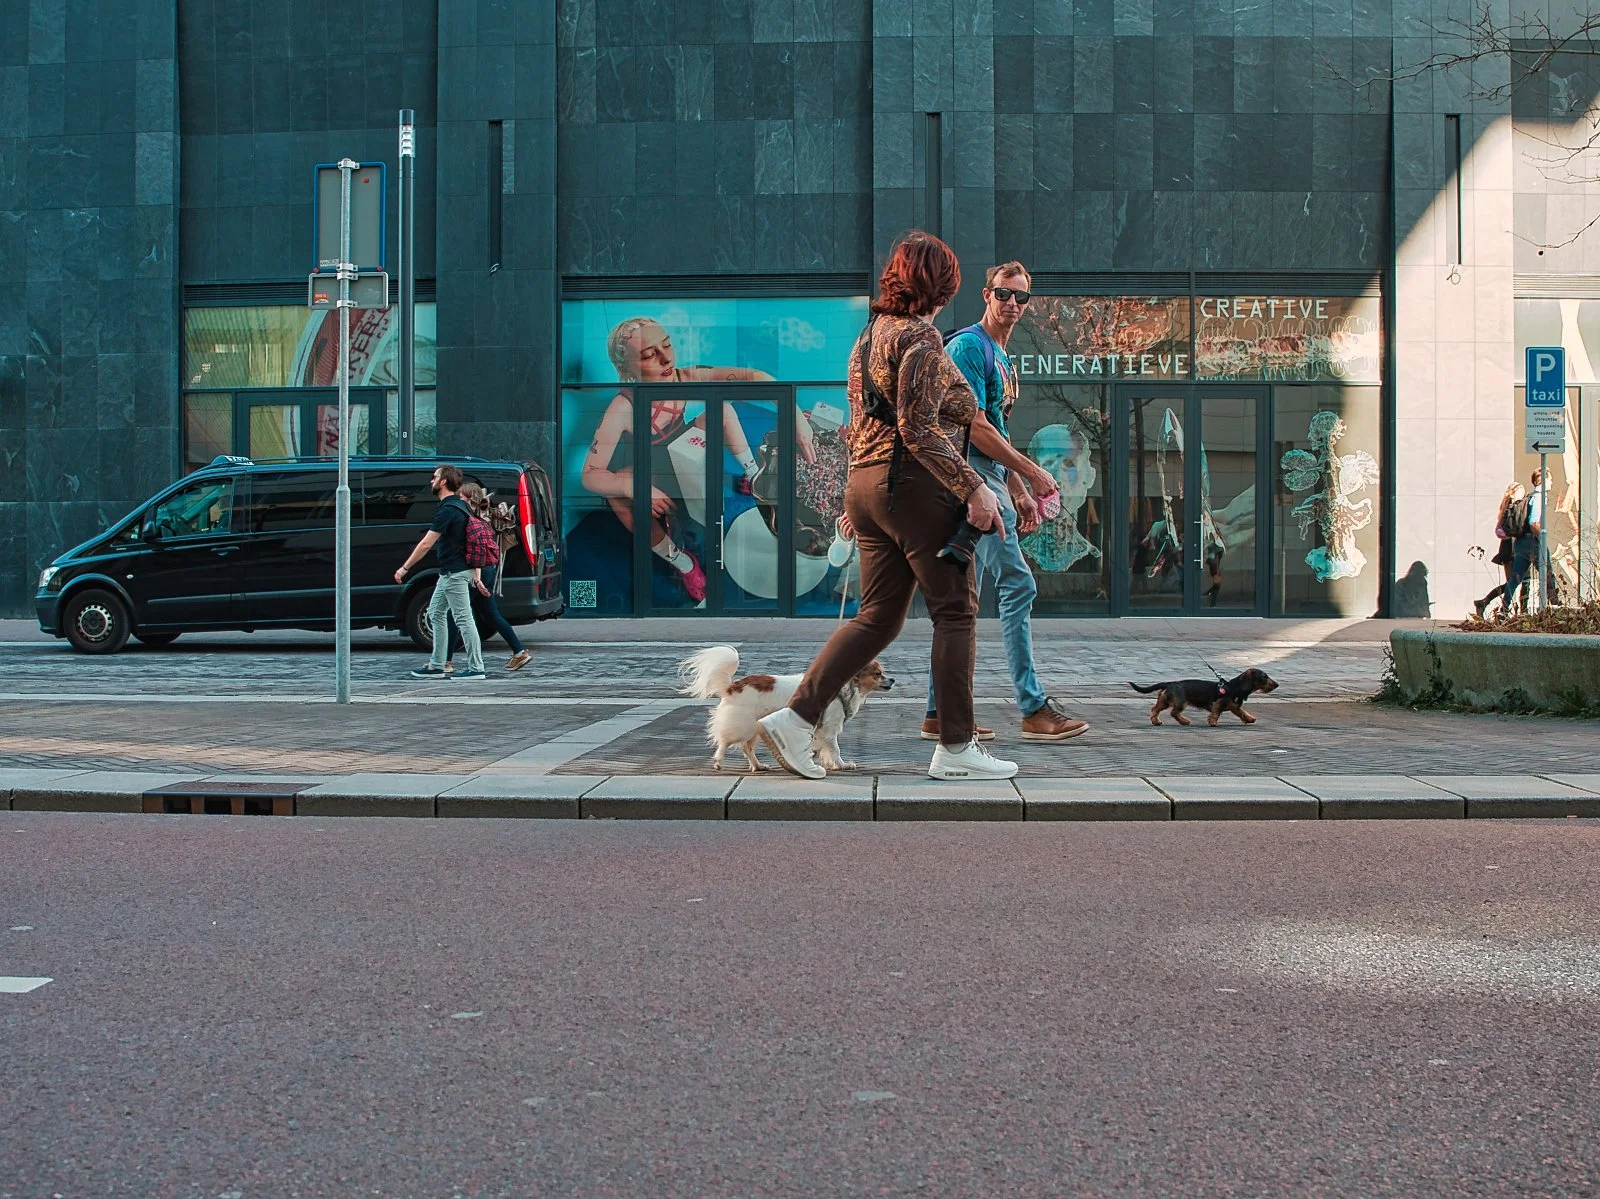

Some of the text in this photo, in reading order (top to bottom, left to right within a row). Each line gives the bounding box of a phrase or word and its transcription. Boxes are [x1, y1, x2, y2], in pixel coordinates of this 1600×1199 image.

[1200, 299, 1329, 319] CREATIVE
[1536, 353, 1556, 382] P
[1532, 389, 1560, 400] taxi
